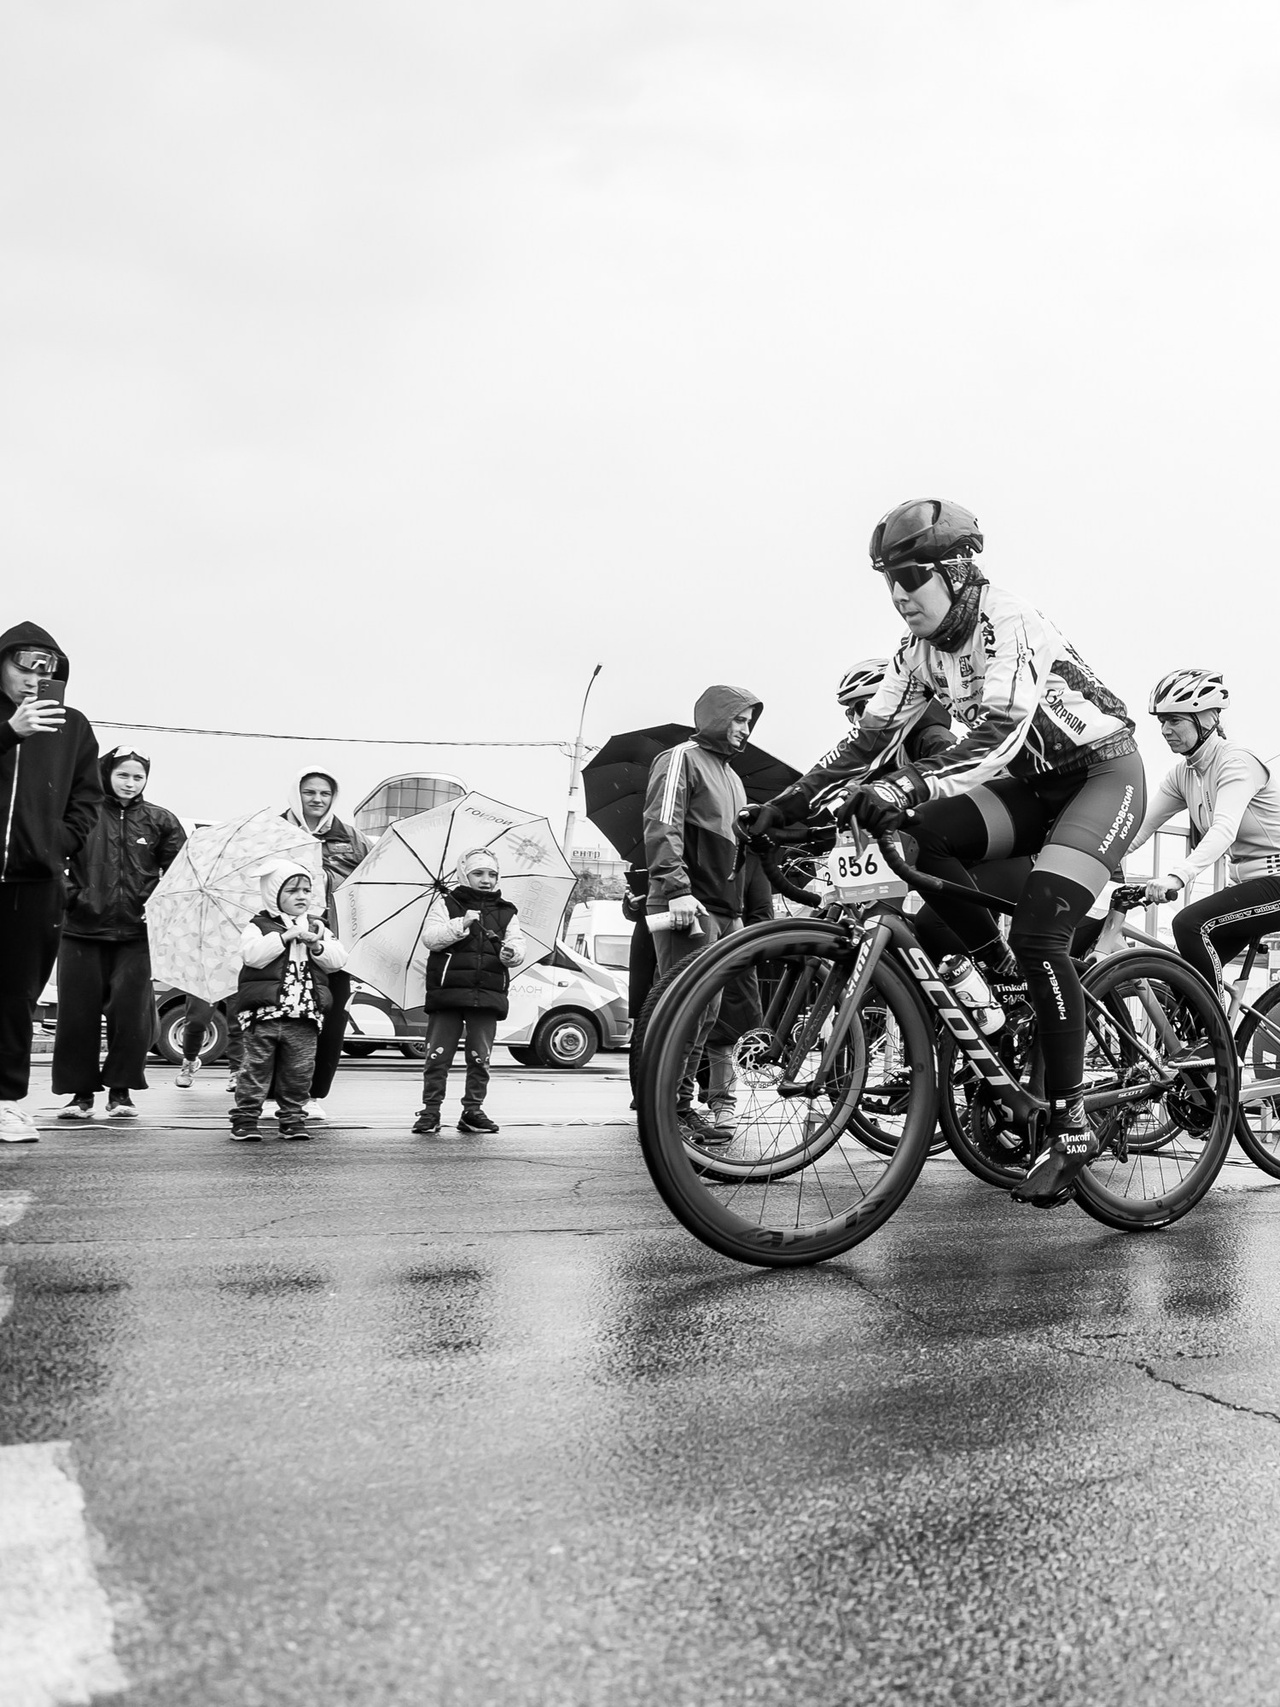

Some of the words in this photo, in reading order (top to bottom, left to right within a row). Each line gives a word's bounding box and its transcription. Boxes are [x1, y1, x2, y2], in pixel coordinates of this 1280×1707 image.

[1098, 784, 1135, 854] ХАБАРОВСКИЙ
[1119, 812, 1135, 840] КРАЙ
[838, 853, 878, 878] 856
[993, 982, 1028, 992] Tinkoff
[1042, 960, 1067, 1021] PINARELLO
[898, 947, 1020, 1092] SCOTT
[1117, 1088, 1145, 1099] SCOTT
[1058, 1131, 1092, 1143] Tinkoff
[1066, 1143, 1088, 1155] SAXO
